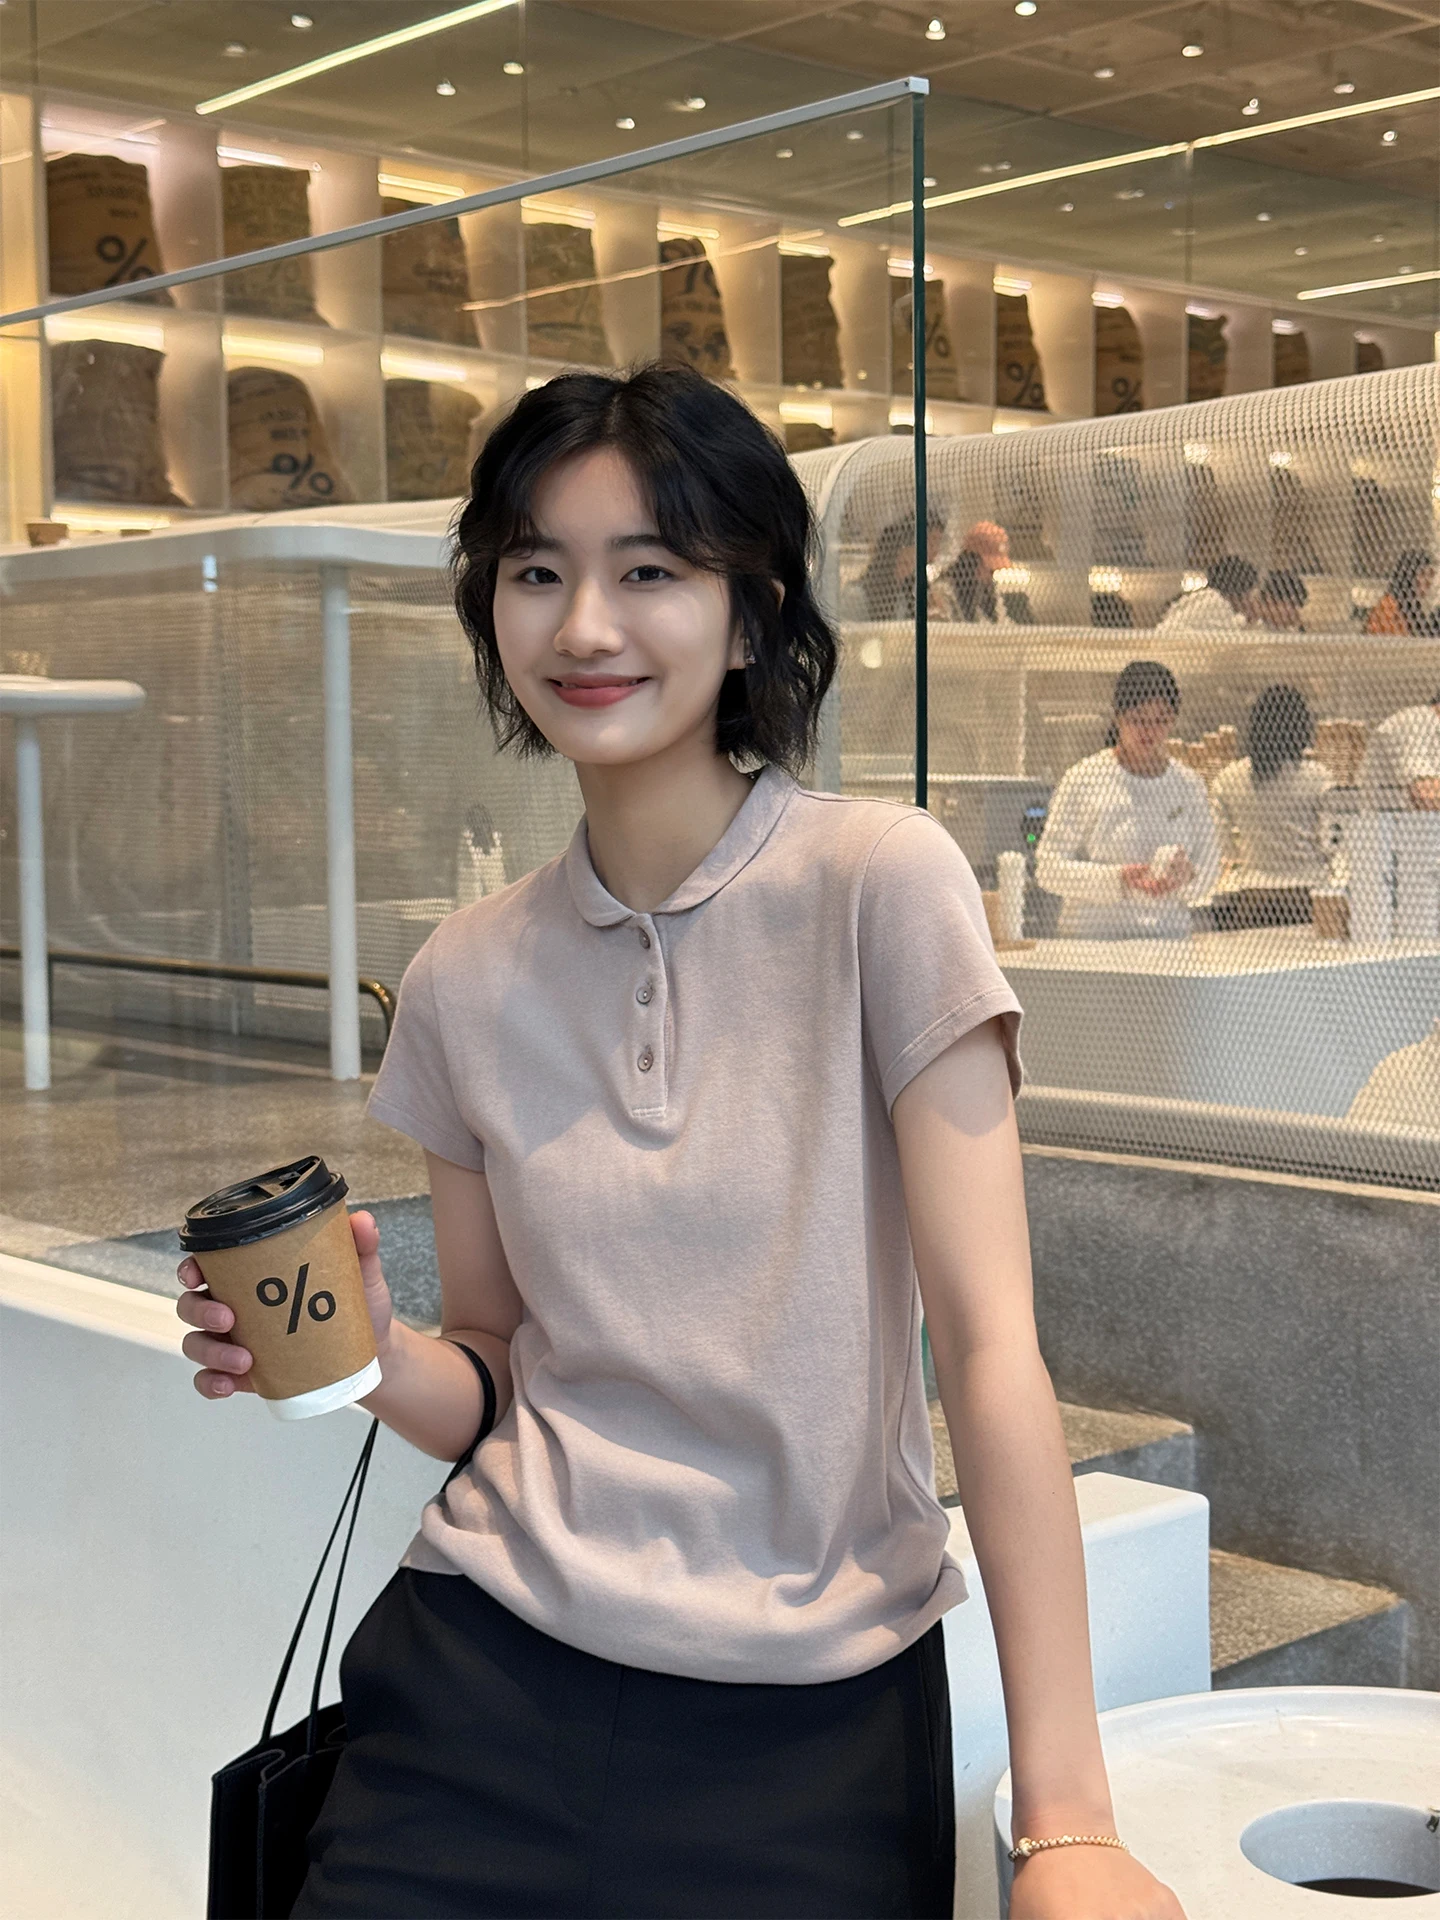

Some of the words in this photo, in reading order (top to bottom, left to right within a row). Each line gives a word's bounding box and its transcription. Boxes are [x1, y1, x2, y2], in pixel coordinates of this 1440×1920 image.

[1006, 362, 1045, 404] %
[271, 453, 334, 496] %
[256, 1262, 337, 1335] %
